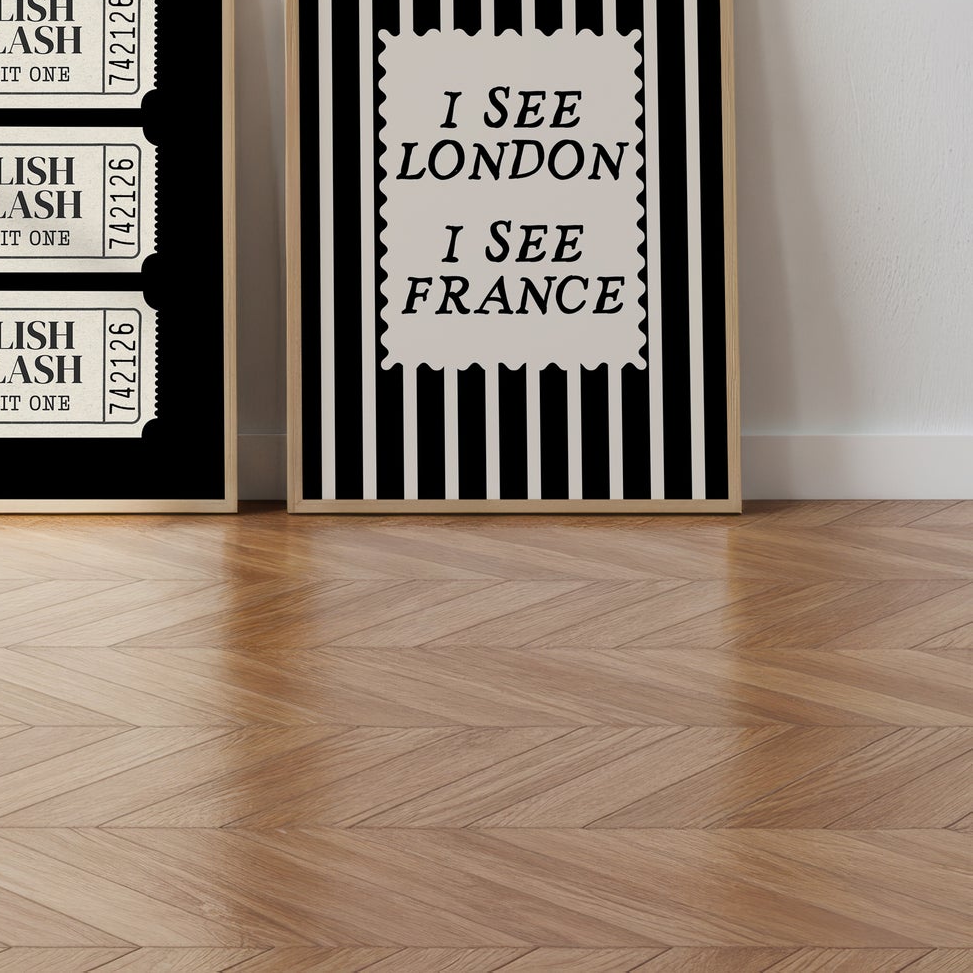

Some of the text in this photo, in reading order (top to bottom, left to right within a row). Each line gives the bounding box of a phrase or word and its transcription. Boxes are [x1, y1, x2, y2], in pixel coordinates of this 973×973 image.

[29, 66, 69, 81] ONE
[439, 85, 581, 128] I SEE
[395, 138, 629, 180] LONDON
[108, 158, 135, 249] 742126
[29, 229, 69, 245] ONE
[441, 219, 583, 263] I SEE
[401, 274, 625, 315] FRANCE
[108, 323, 136, 414] 742126
[29, 395, 69, 410] ONE
